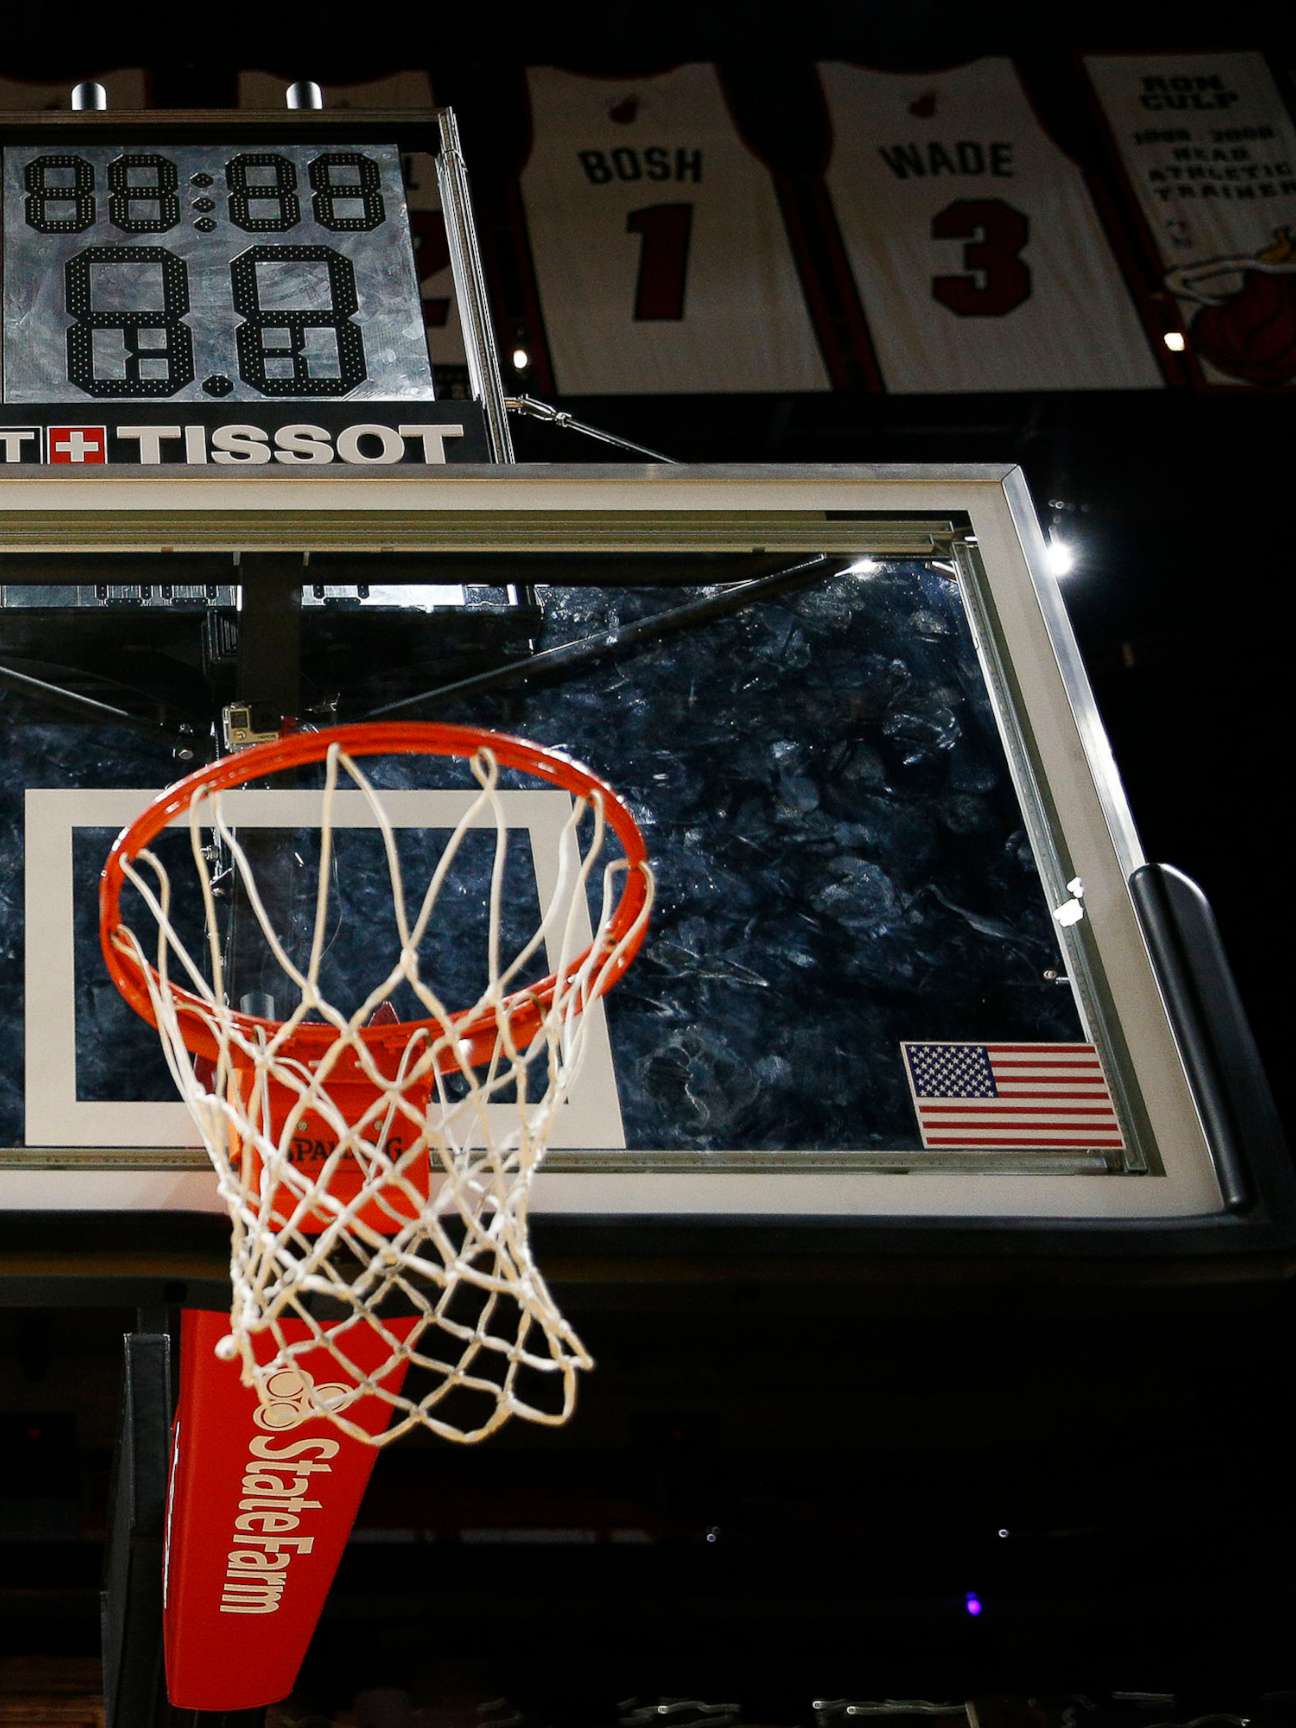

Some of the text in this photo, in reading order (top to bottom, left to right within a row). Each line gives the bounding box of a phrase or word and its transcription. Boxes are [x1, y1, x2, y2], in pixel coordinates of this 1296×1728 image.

[1140, 93, 1238, 110] CULP
[577, 146, 702, 184] BOSH
[878, 139, 1014, 179] WADE
[625, 202, 694, 322] 1
[931, 198, 1032, 317] 3
[116, 423, 465, 465] TISSOT
